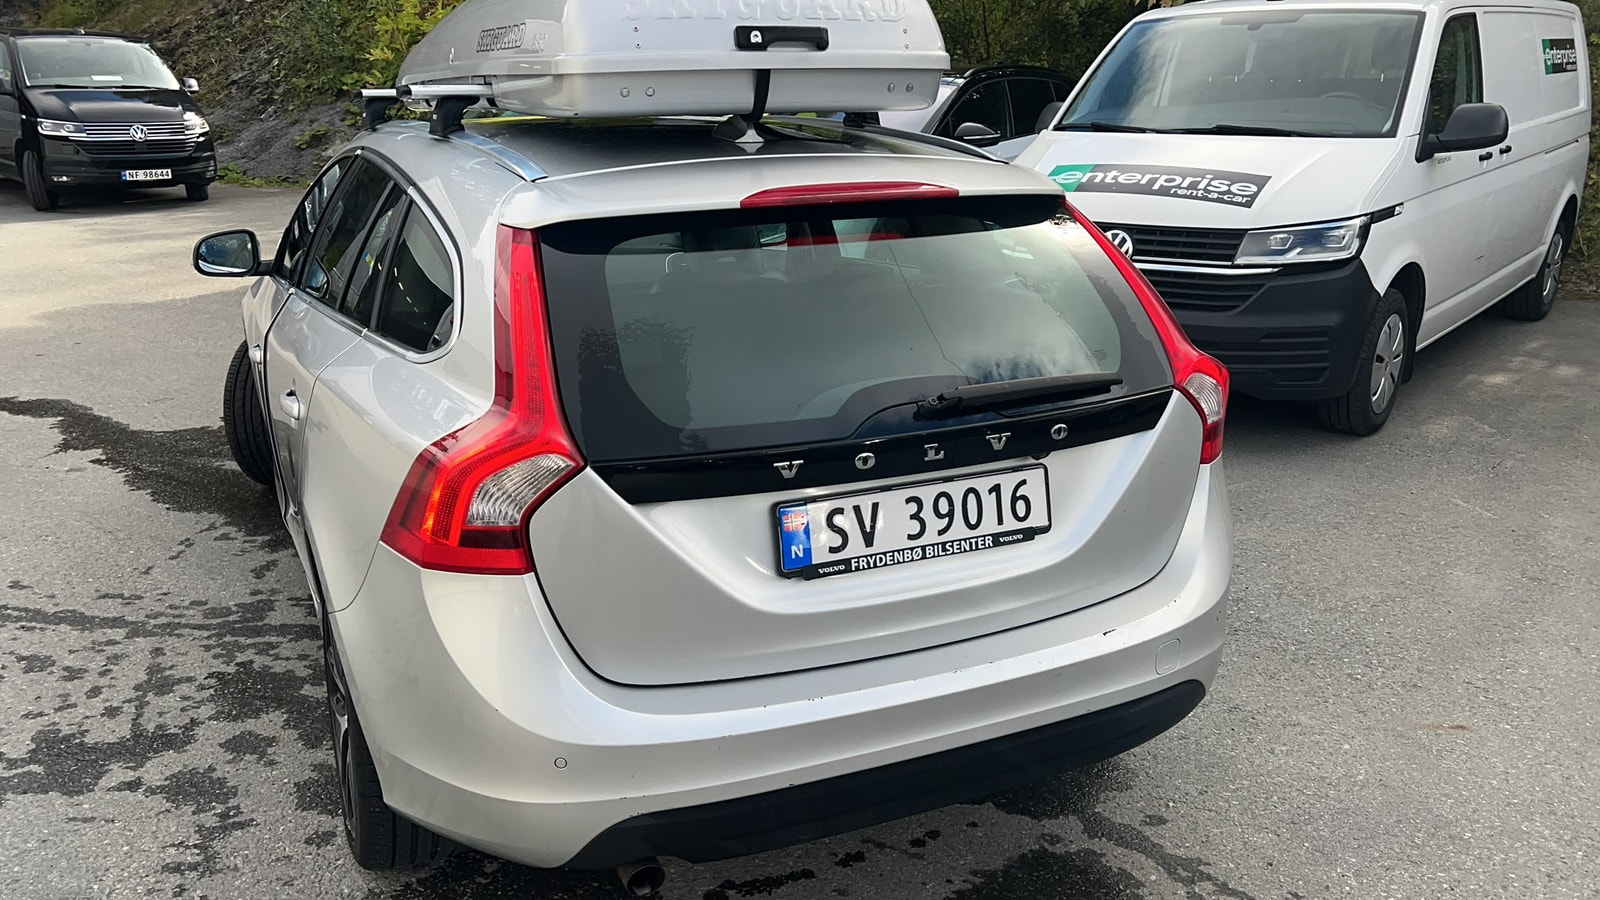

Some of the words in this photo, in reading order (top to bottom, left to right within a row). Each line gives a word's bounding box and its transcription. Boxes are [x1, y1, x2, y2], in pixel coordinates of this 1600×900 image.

[1544, 45, 1576, 68] enterprise
[128, 171, 140, 179] NF
[143, 170, 170, 179] 98644
[1050, 169, 1258, 196] enterprise
[1170, 188, 1251, 204] rent-a-car
[773, 423, 1068, 479] VOLVO
[825, 501, 880, 554] SV
[904, 478, 1032, 541] 39016
[817, 563, 846, 575] VOLVO
[850, 548, 923, 572] FRYDENBØ
[925, 535, 994, 559] BILSENTER
[999, 533, 1024, 543] VOLVO
